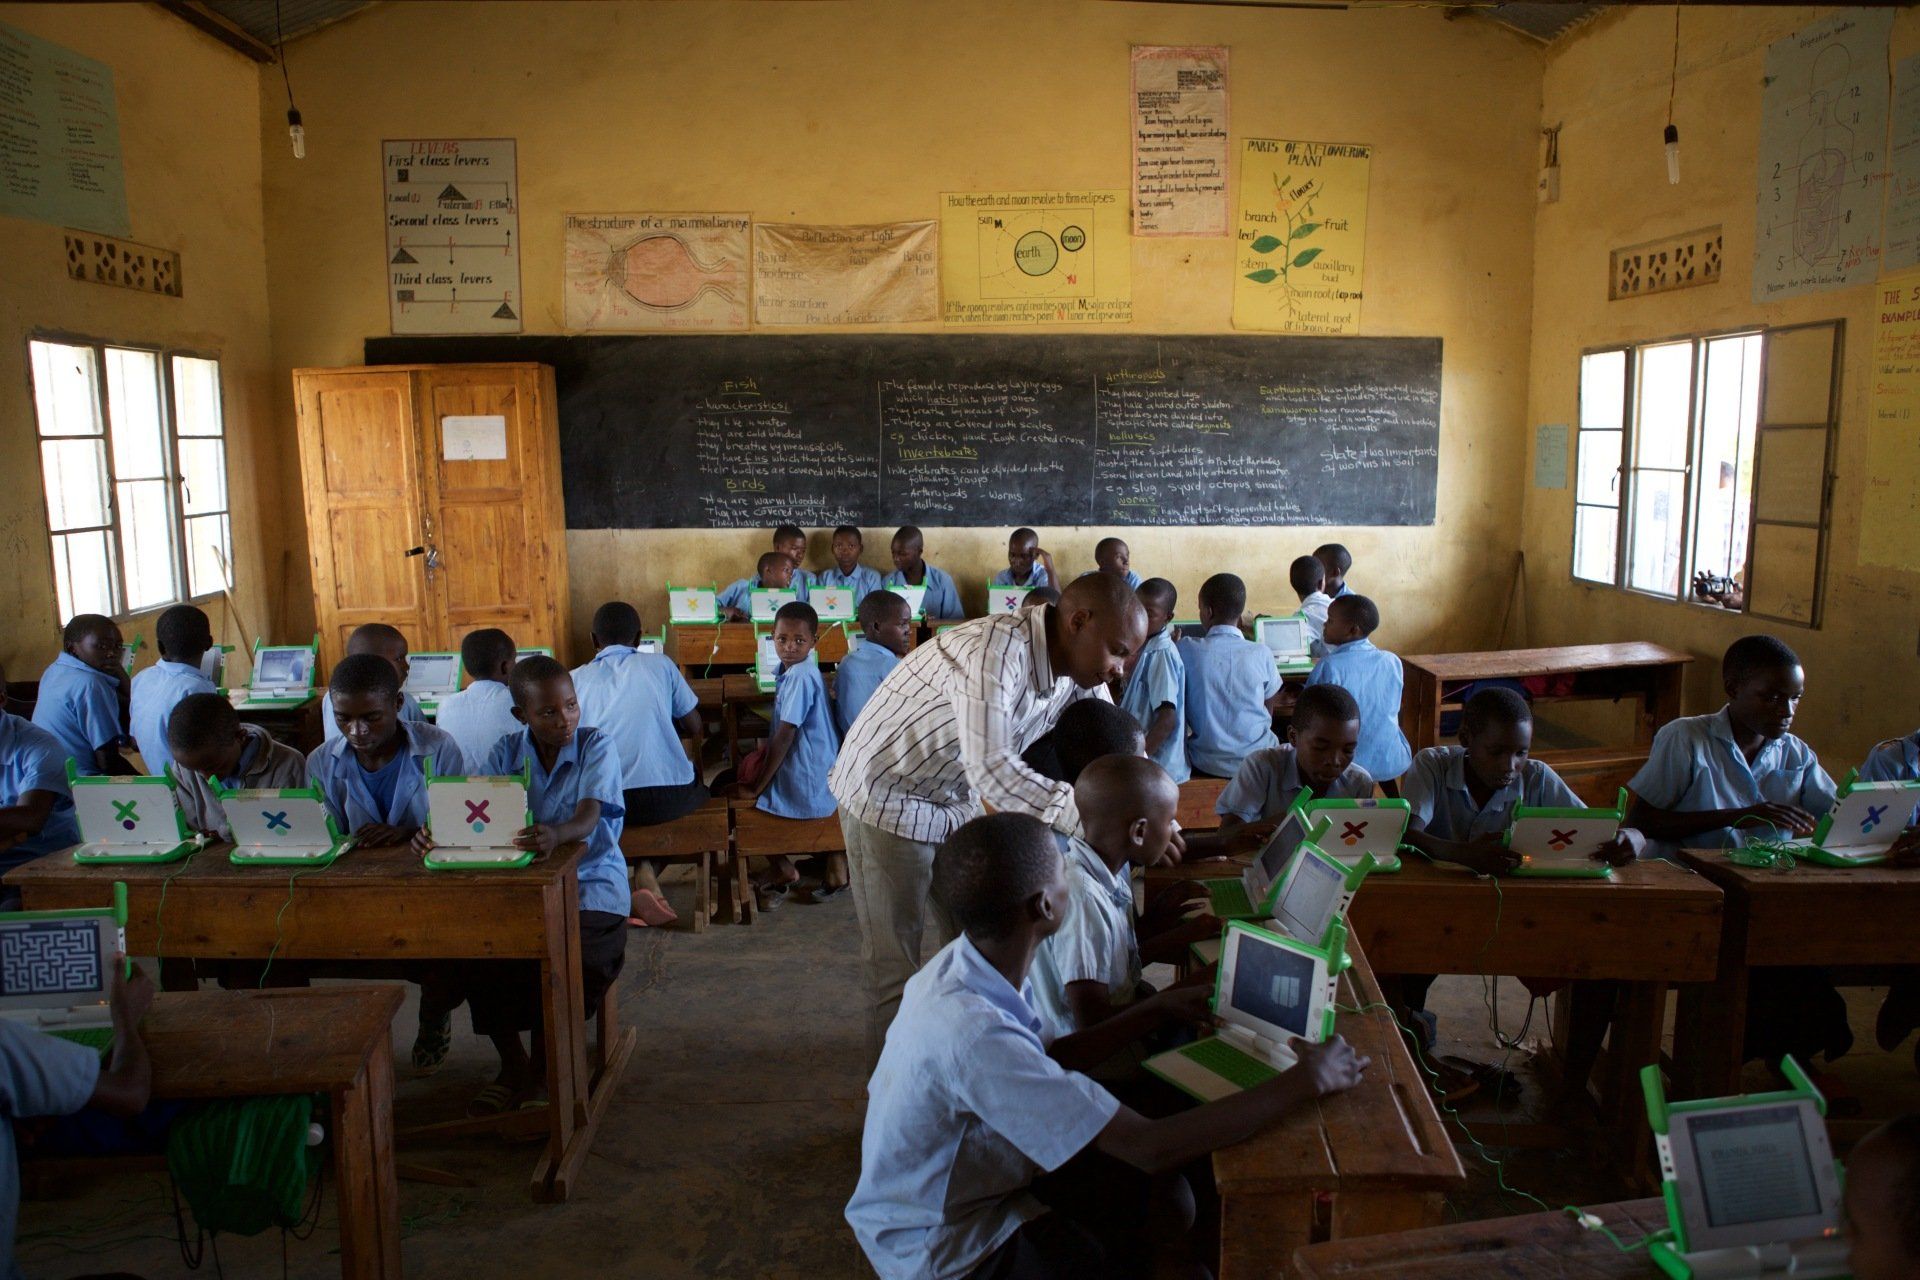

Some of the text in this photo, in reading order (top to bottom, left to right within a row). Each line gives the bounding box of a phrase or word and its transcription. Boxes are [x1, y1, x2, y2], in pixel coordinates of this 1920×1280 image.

[1247, 141, 1278, 152] PARTS
[420, 156, 450, 166] class
[454, 155, 490, 166] levers
[1288, 154, 1323, 167] PLANT
[1864, 151, 1874, 161] 10
[1773, 162, 1781, 179] 2
[389, 214, 499, 225] Second class levers
[641, 216, 652, 227] of
[654, 219, 662, 227] a
[1244, 210, 1277, 223] branch
[1324, 219, 1348, 232] fruit
[1238, 229, 1259, 240] leaf
[1017, 246, 1040, 259] earth
[1241, 260, 1268, 270] stem
[426, 274, 453, 284] class
[460, 273, 492, 284] levers
[899, 448, 978, 459] Invertebrates
[726, 478, 766, 489] Birds
